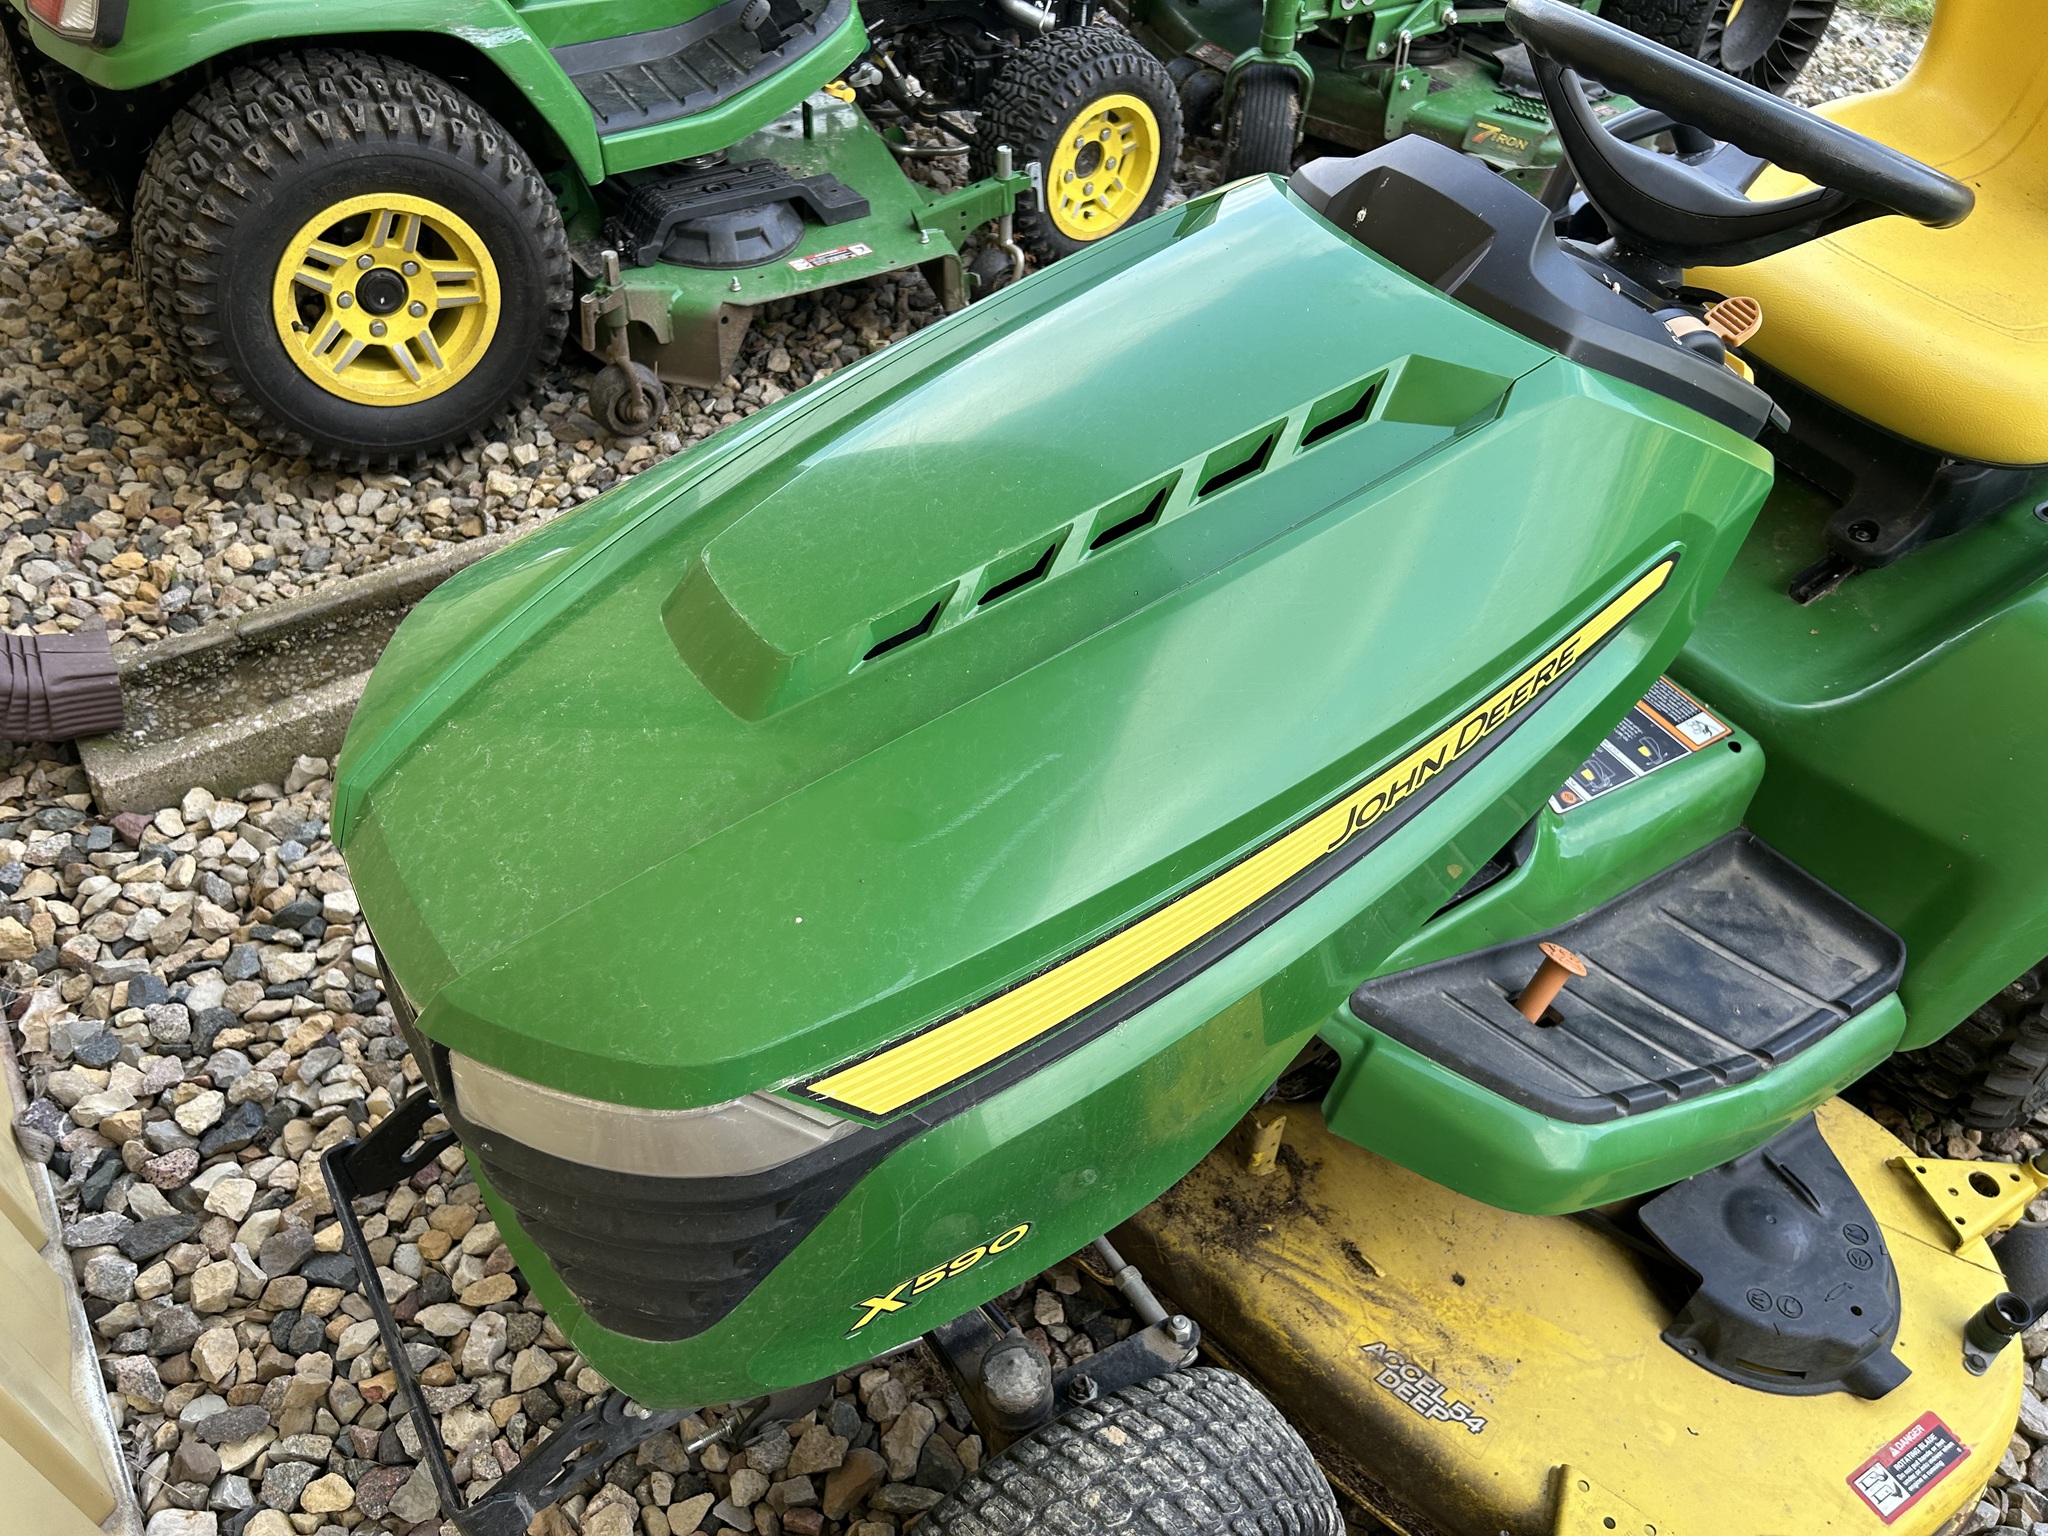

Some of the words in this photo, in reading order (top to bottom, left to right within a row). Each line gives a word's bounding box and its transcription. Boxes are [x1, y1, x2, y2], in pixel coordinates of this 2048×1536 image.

[1327, 743, 1448, 851] JOHN
[1453, 636, 1581, 758] DEERE
[843, 1222, 1032, 1337] X590
[1360, 1341, 1449, 1408] ACCEL
[1448, 1400, 1488, 1435] 54
[1373, 1368, 1451, 1422] DEEP
[1893, 1447, 1922, 1471] ROTATING
[1918, 1433, 1938, 1451] BLADE
[1894, 1424, 1925, 1451] DANGER
